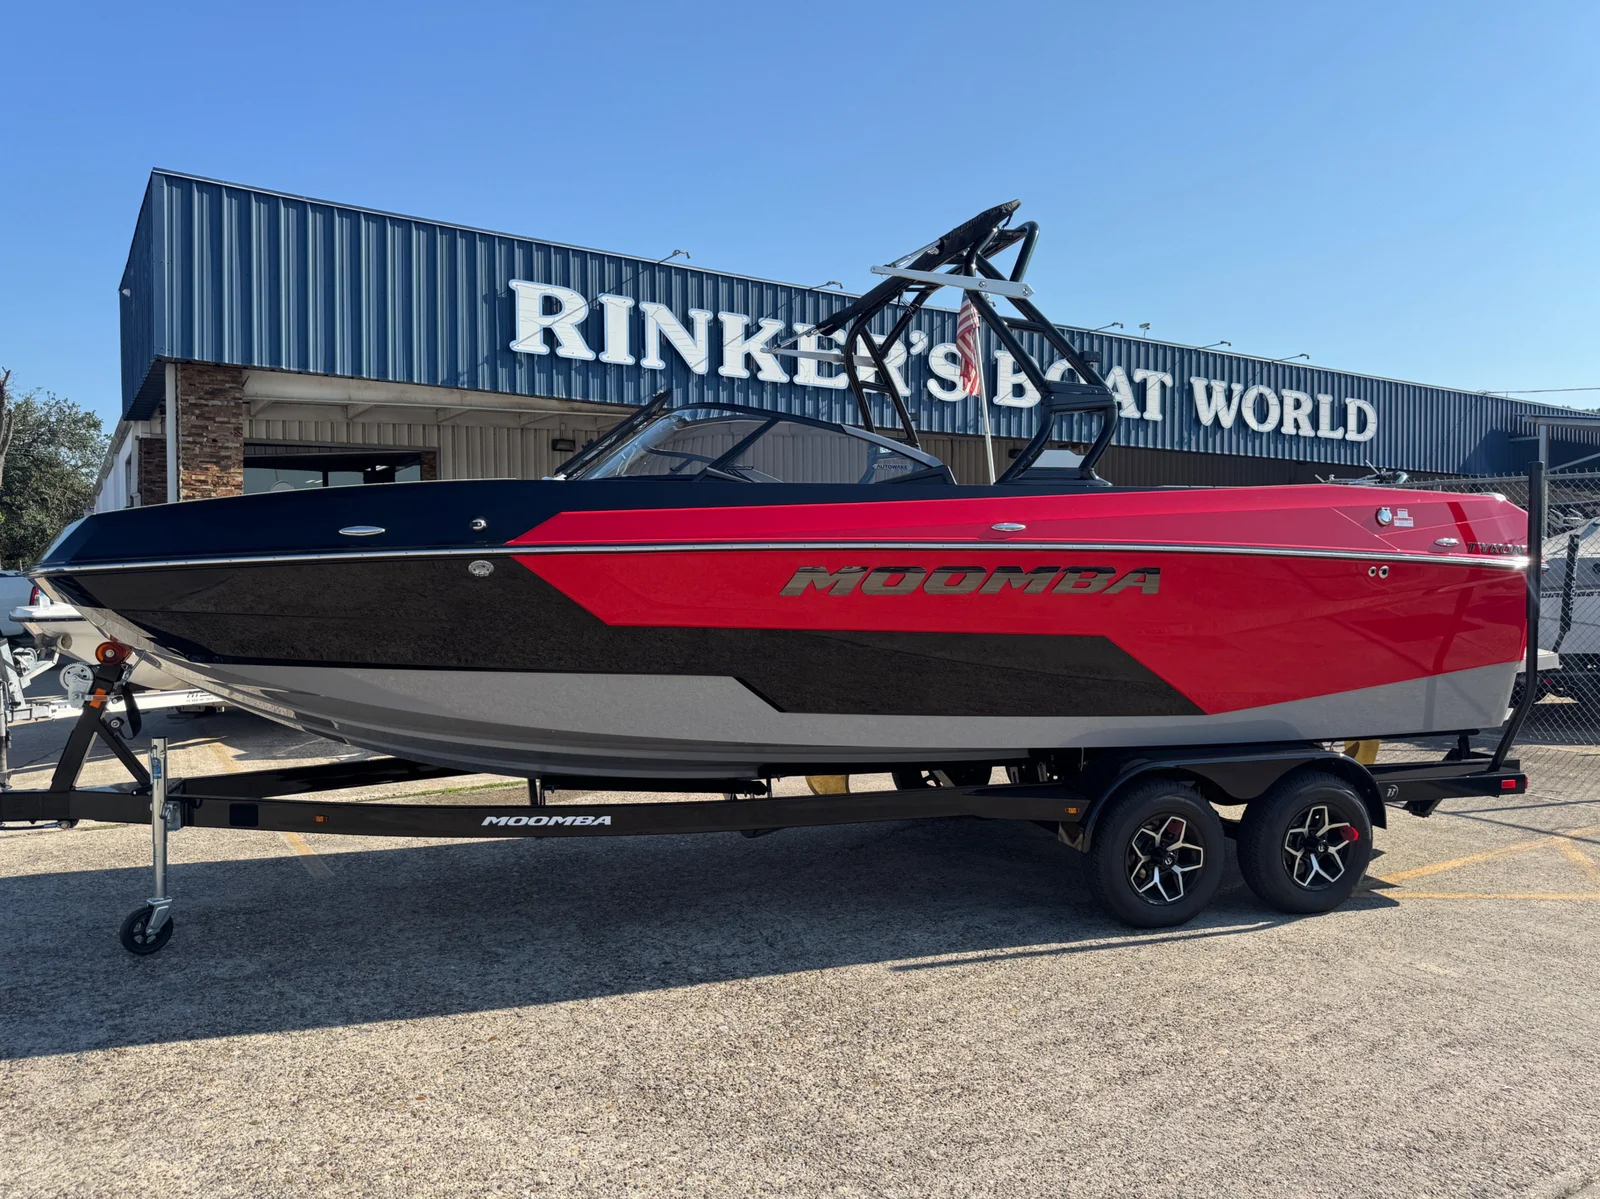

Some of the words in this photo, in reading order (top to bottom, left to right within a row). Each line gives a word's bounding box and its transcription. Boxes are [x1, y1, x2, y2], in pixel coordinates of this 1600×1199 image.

[508, 278, 970, 403] RINKER'S
[1189, 376, 1378, 442] WORLD
[779, 565, 1162, 597] MOOMBA
[481, 815, 612, 827] MOOMBA
